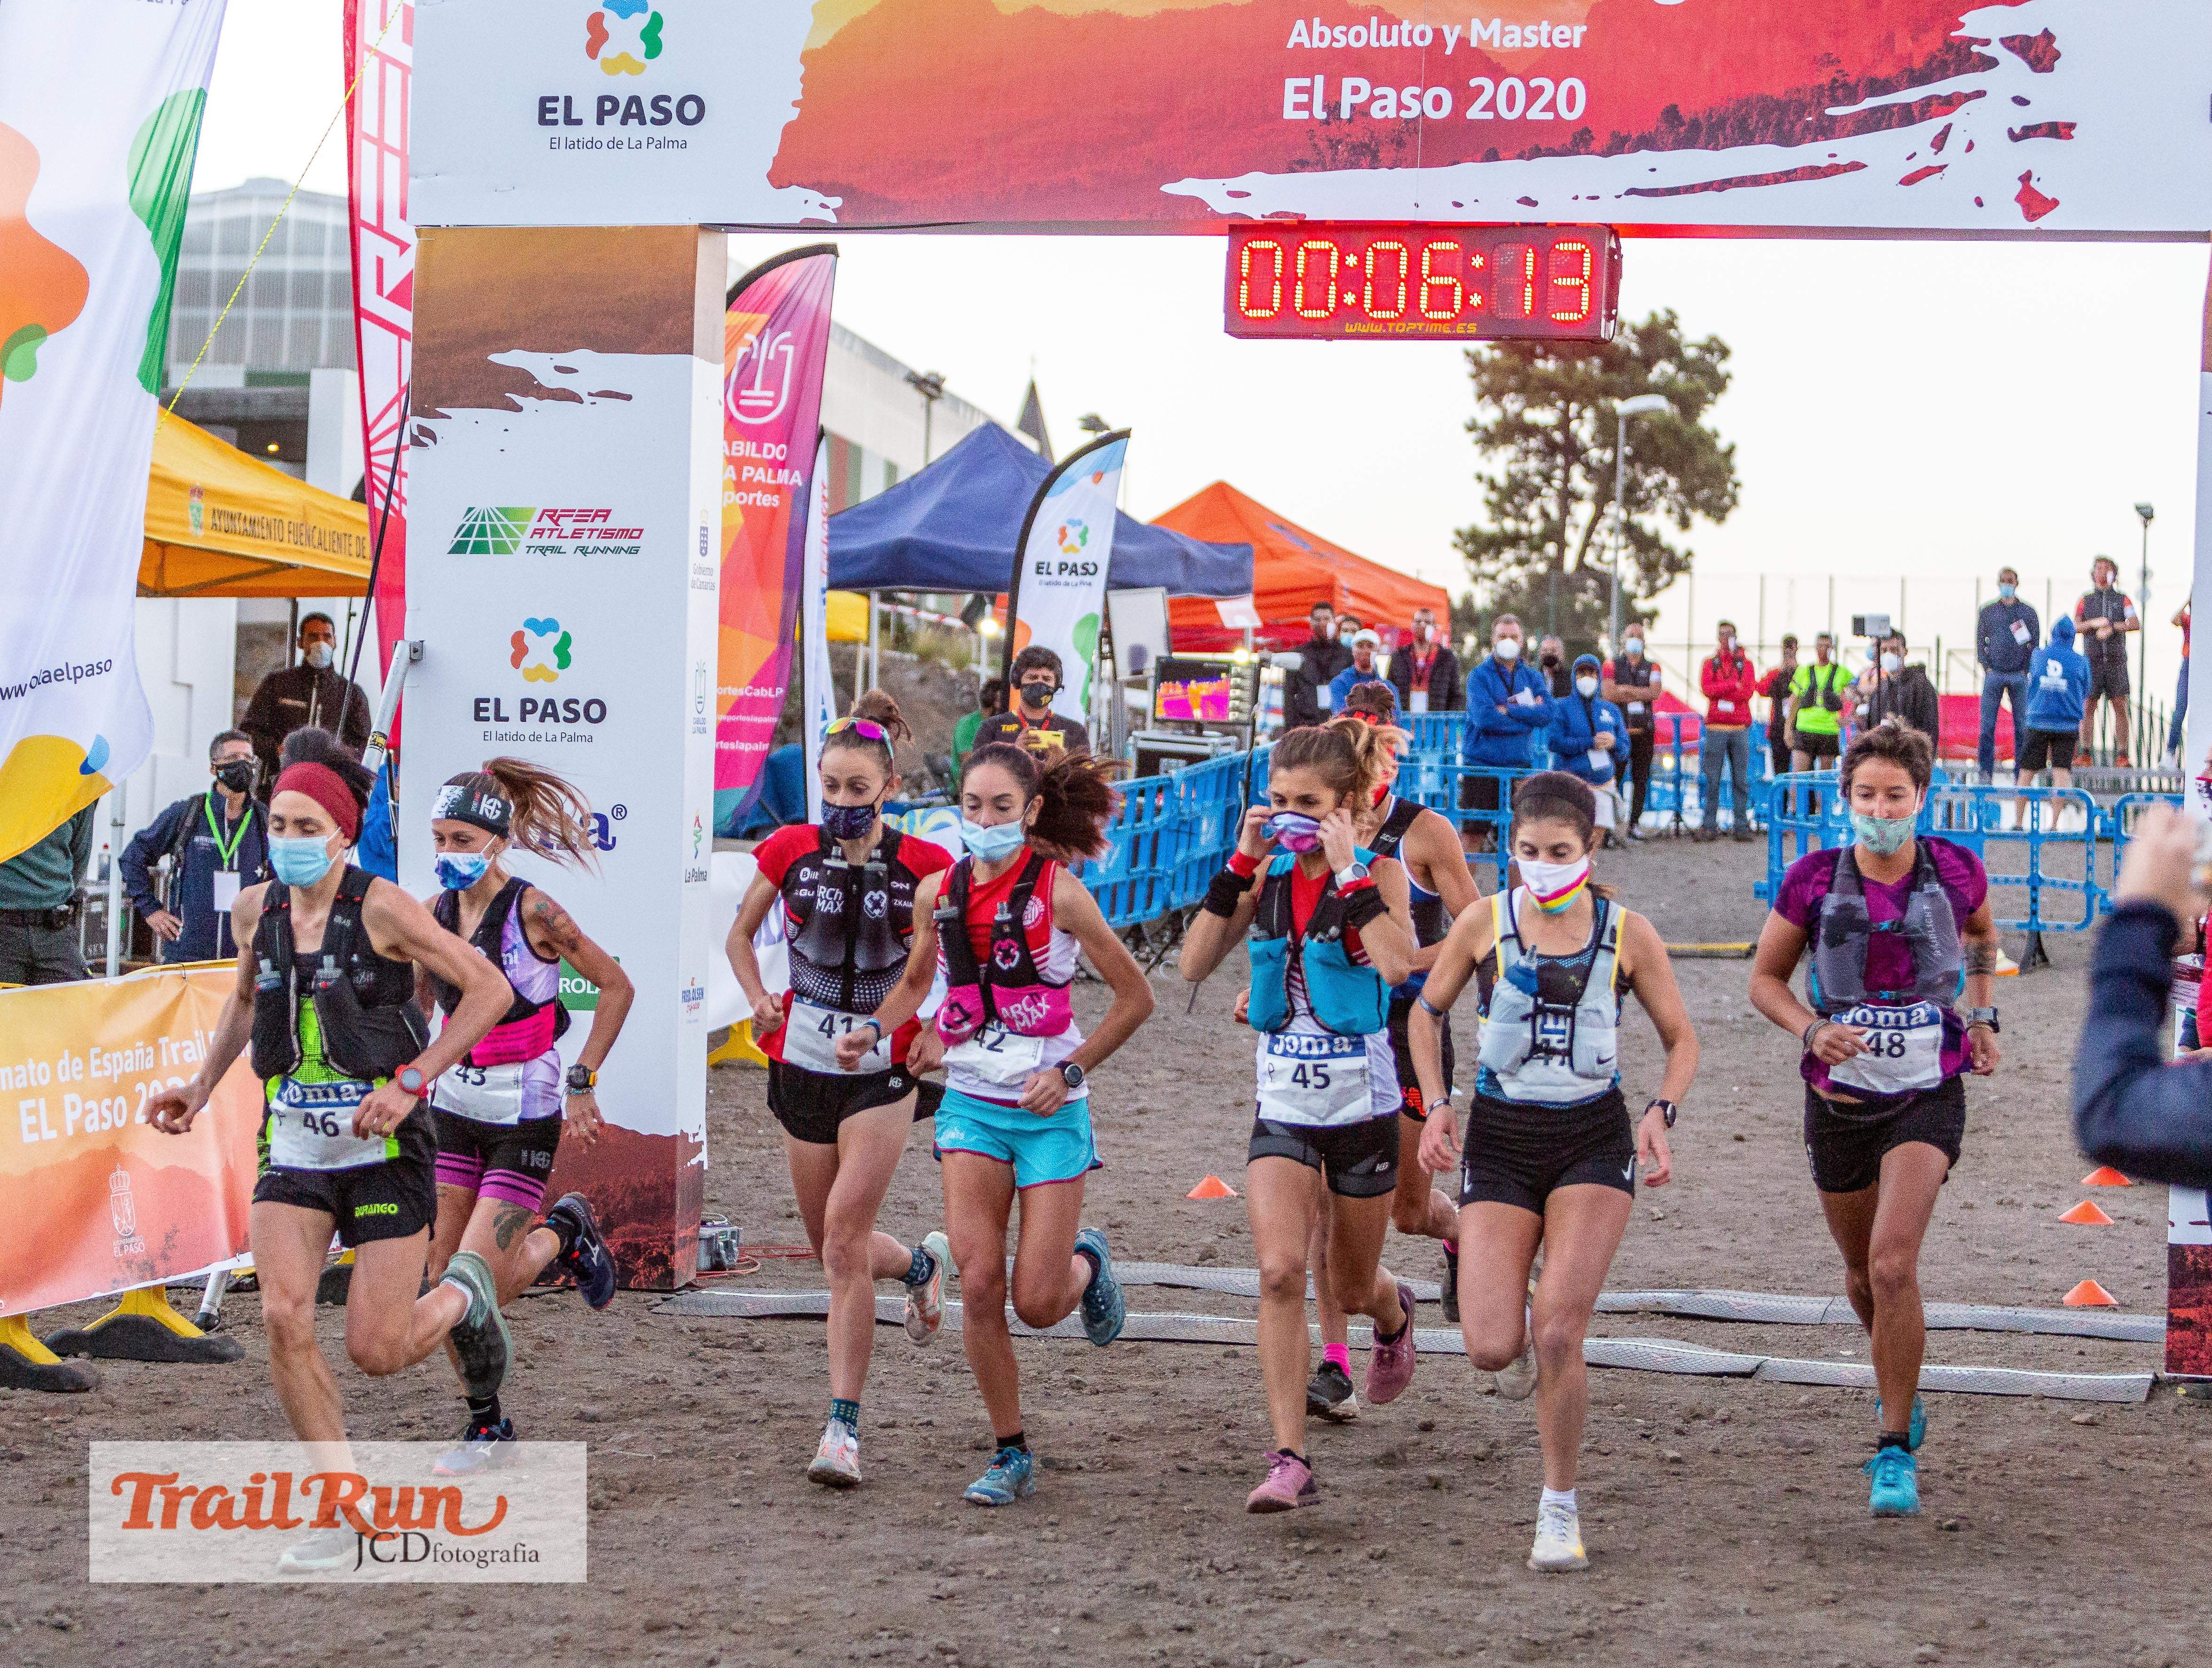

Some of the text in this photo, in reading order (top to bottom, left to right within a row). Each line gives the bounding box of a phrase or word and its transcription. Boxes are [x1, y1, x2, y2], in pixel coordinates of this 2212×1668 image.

[1286, 17, 1587, 55] Absoluto y Master
[1282, 74, 1587, 120] El Paso 2020
[538, 94, 706, 126] EL PASO
[549, 136, 687, 150] El latido de La Palma
[1344, 321, 1477, 334] WWW.TOPTIME.ES
[741, 466, 803, 486] PALMA
[722, 490, 780, 507] portes
[537, 509, 612, 526] RFEA
[211, 508, 366, 559] AYUNTAMIENTO FUENCALIENTE DE
[530, 528, 644, 539] ATLETISMO
[526, 545, 641, 556] TRAIL RUNNING
[693, 564, 713, 576] Gobierno
[1035, 561, 1098, 576] EL PASO
[690, 577, 715, 591] de Canarias
[473, 697, 607, 724] EL PASO
[483, 730, 593, 743] El latido de La Palma
[684, 867, 707, 883] La Palma
[816, 898, 844, 913] MAX
[1866, 1032, 1906, 1058] 48
[0, 1057, 50, 1091] nato
[57, 1049, 83, 1082] de
[89, 1041, 154, 1083] España
[158, 1030, 207, 1066] Trail
[1291, 1063, 1330, 1089] 45
[19, 1097, 57, 1143] EL
[63, 1093, 127, 1136] Paso
[303, 1111, 340, 1137] 46
[114, 1242, 145, 1258] EL PASO
